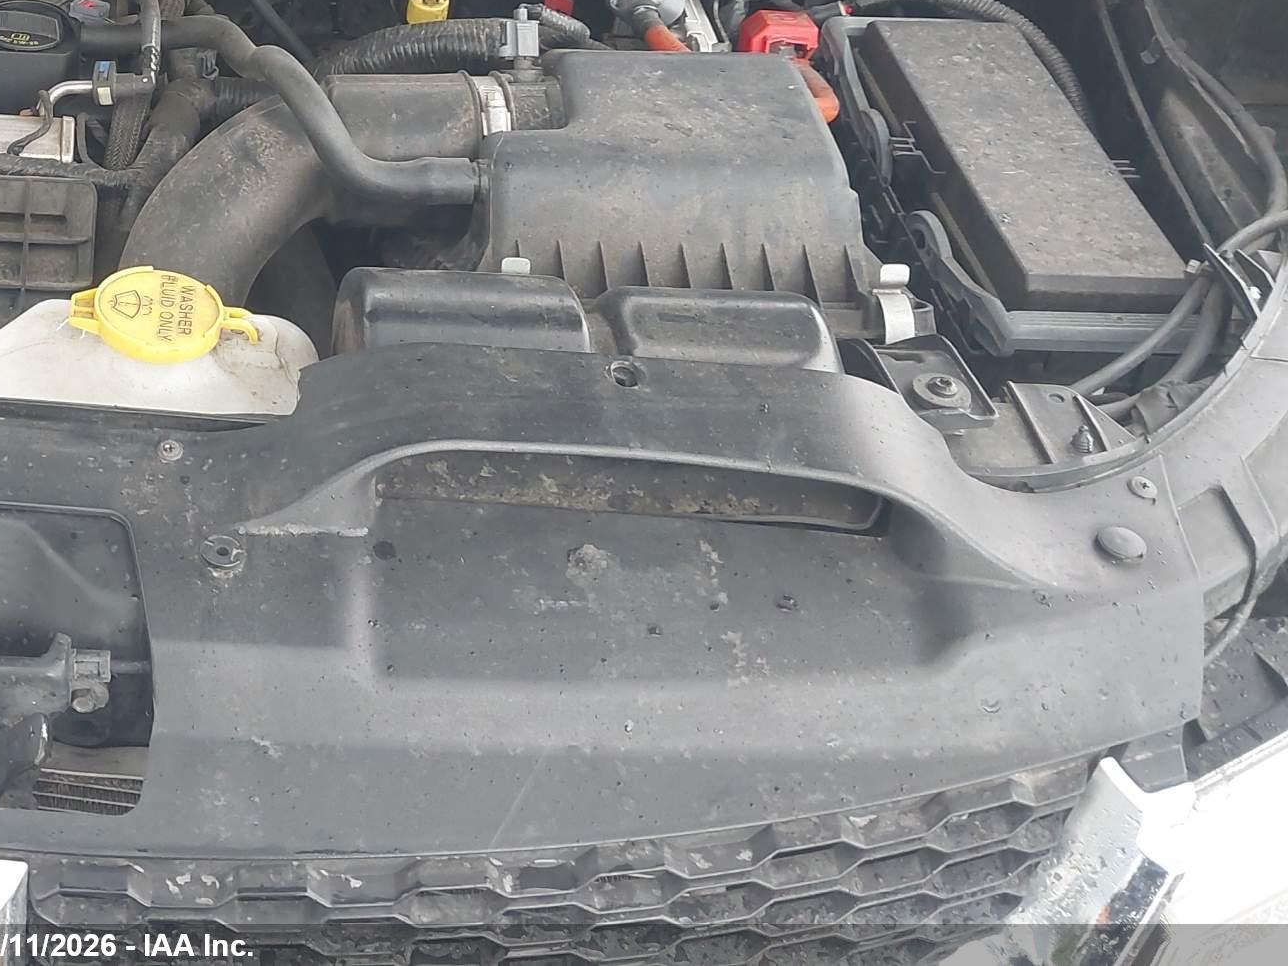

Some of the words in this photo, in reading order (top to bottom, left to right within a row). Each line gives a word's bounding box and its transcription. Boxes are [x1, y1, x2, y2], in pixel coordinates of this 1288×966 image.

[161, 274, 178, 308] FLUID
[157, 311, 175, 342] ONLY
[178, 285, 196, 336] WASHER
